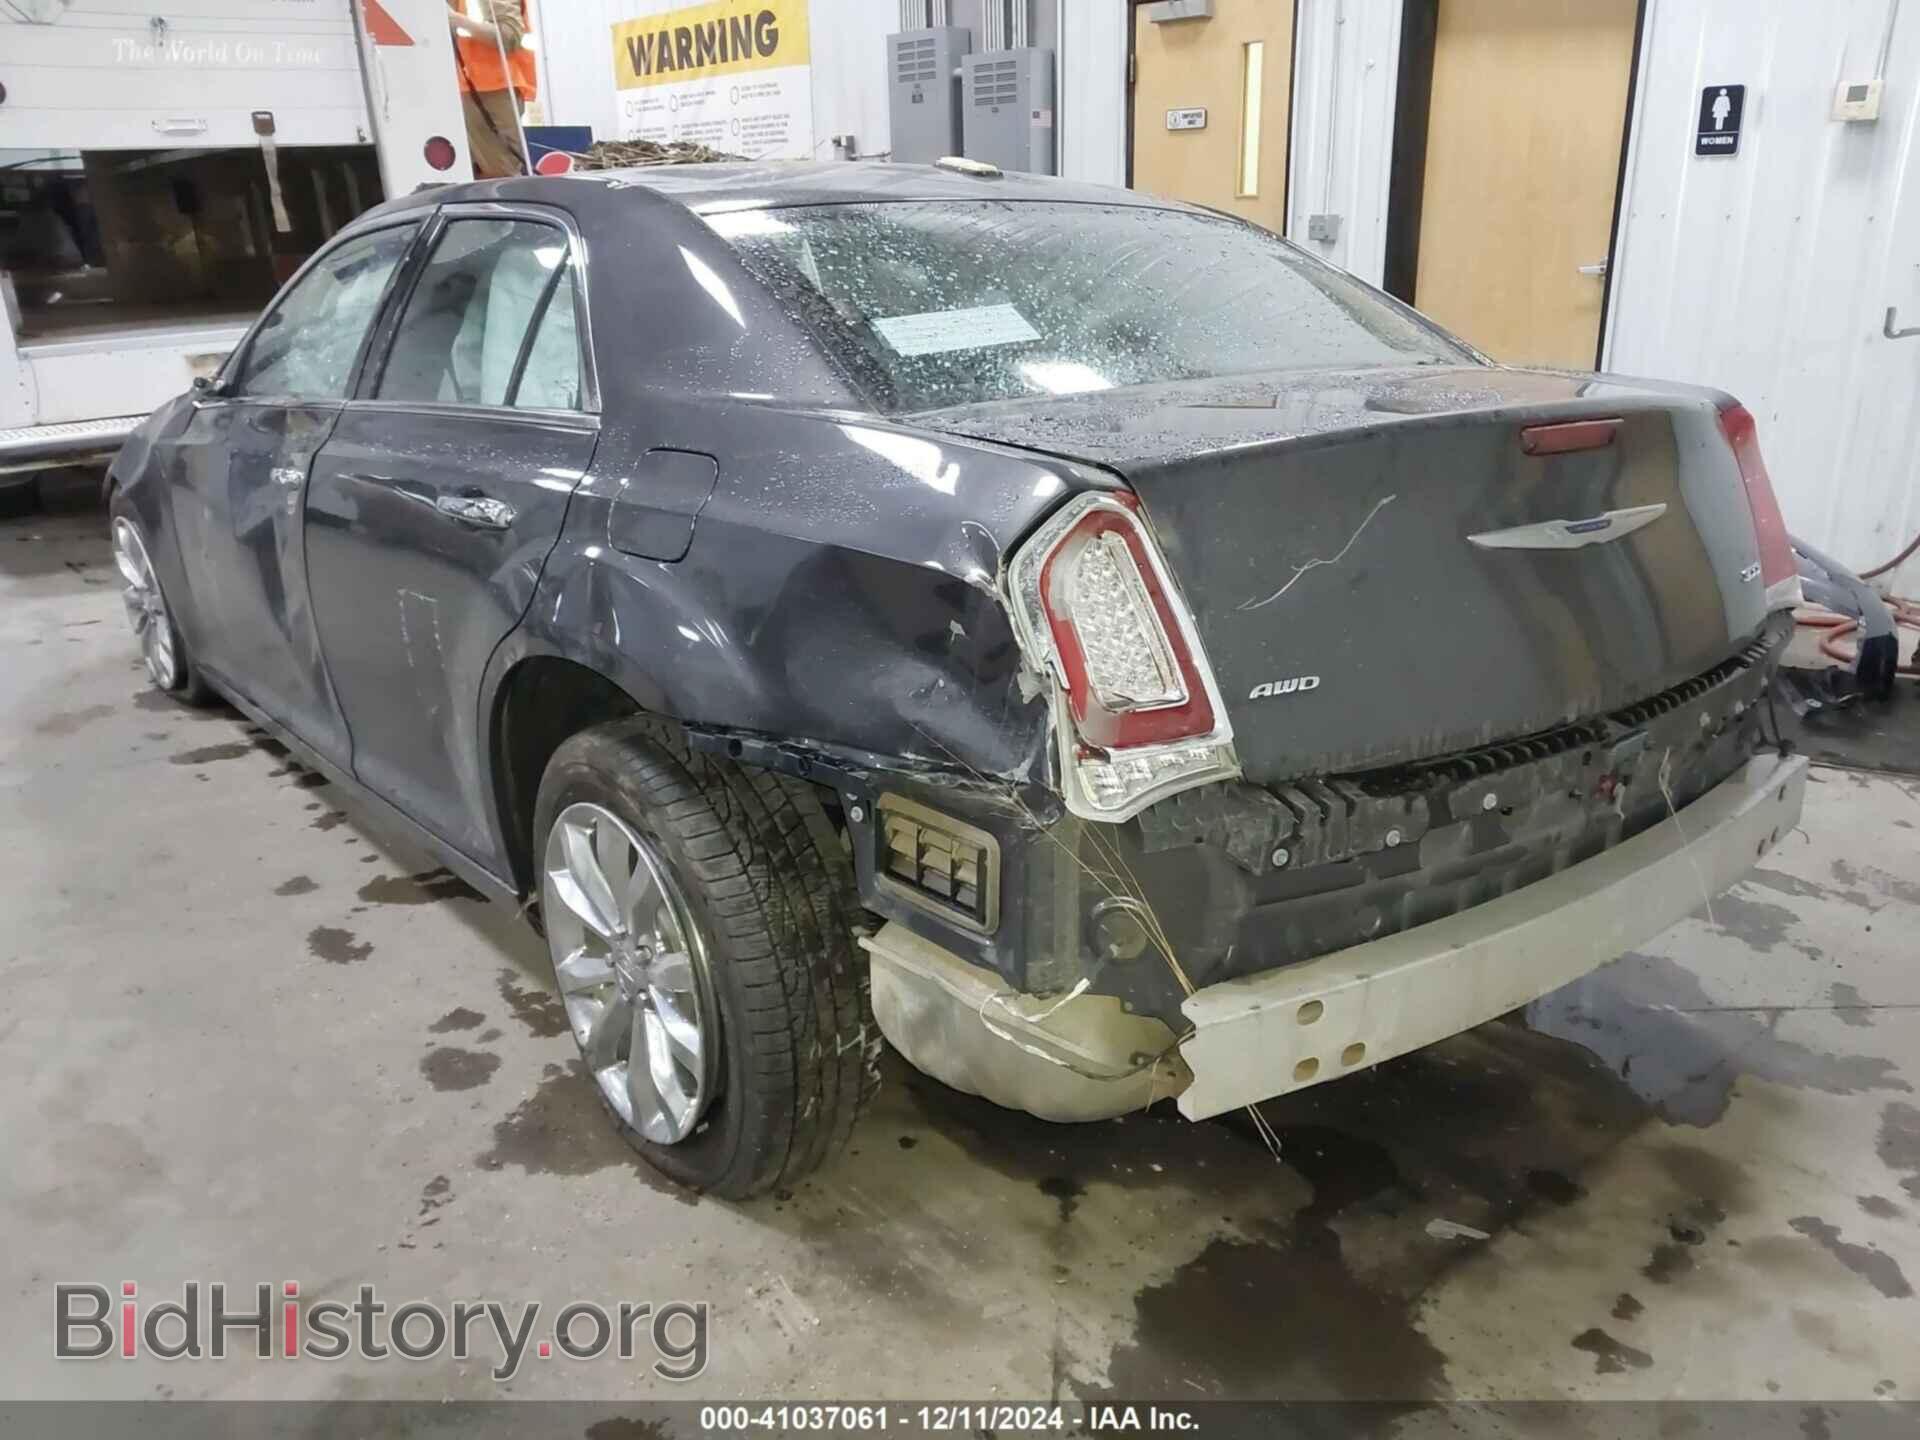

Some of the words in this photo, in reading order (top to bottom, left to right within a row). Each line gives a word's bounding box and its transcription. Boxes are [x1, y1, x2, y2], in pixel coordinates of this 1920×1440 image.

[112, 39, 155, 64] The
[165, 39, 229, 65] World
[235, 40, 265, 64] On
[626, 10, 779, 77] WARNING
[1701, 135, 1735, 145] WOMEN
[1248, 676, 1321, 699] AWD
